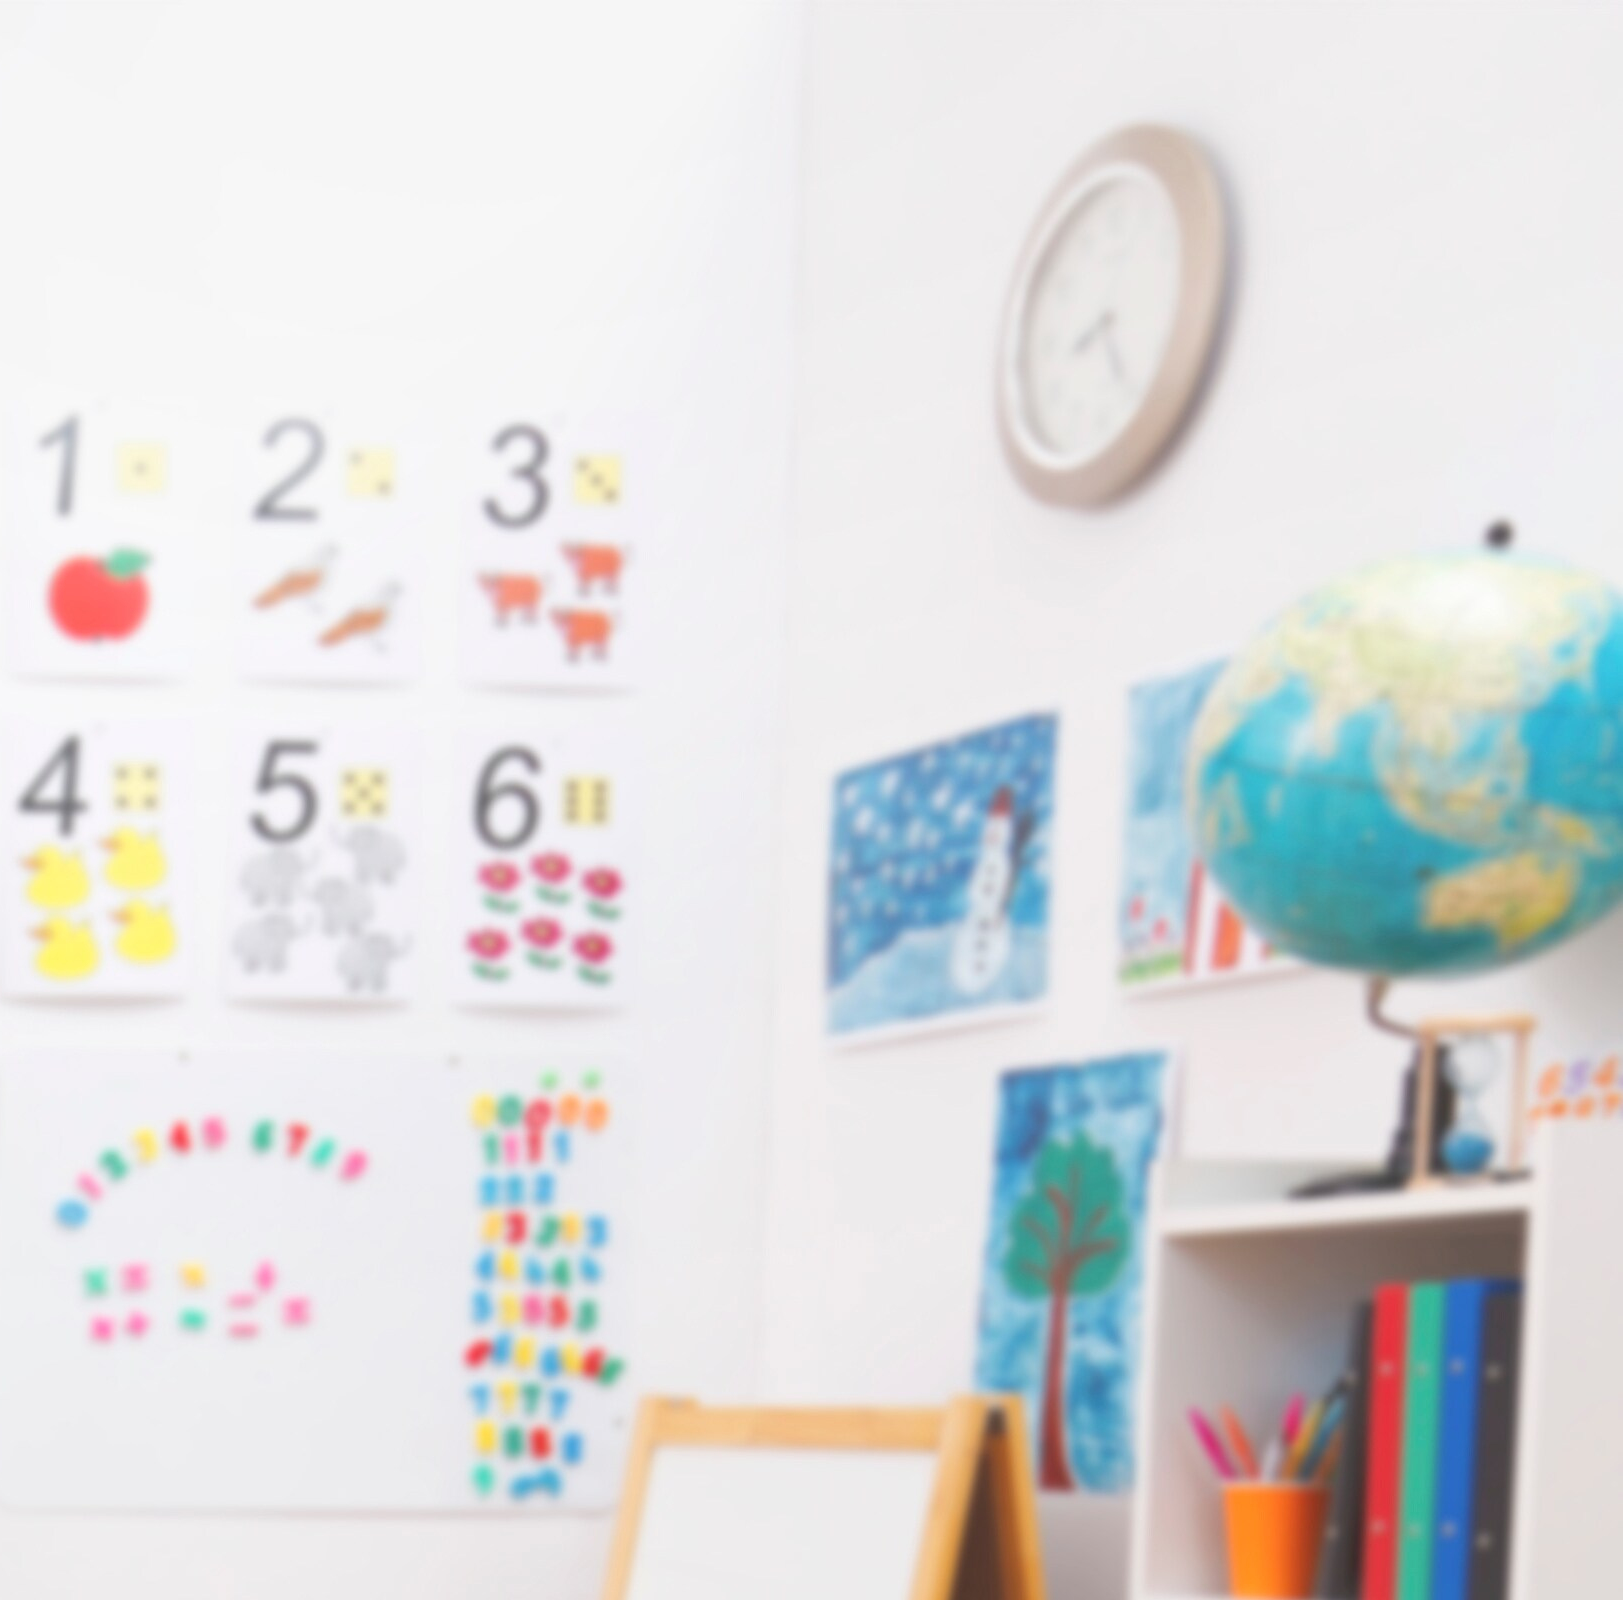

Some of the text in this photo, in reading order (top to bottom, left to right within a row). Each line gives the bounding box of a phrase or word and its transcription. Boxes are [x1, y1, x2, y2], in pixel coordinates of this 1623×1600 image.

[40, 415, 79, 518] 1
[251, 418, 325, 523] 2
[482, 423, 551, 530] 3
[17, 735, 87, 837] 4
[249, 739, 319, 846] 5
[472, 745, 544, 852] 6
